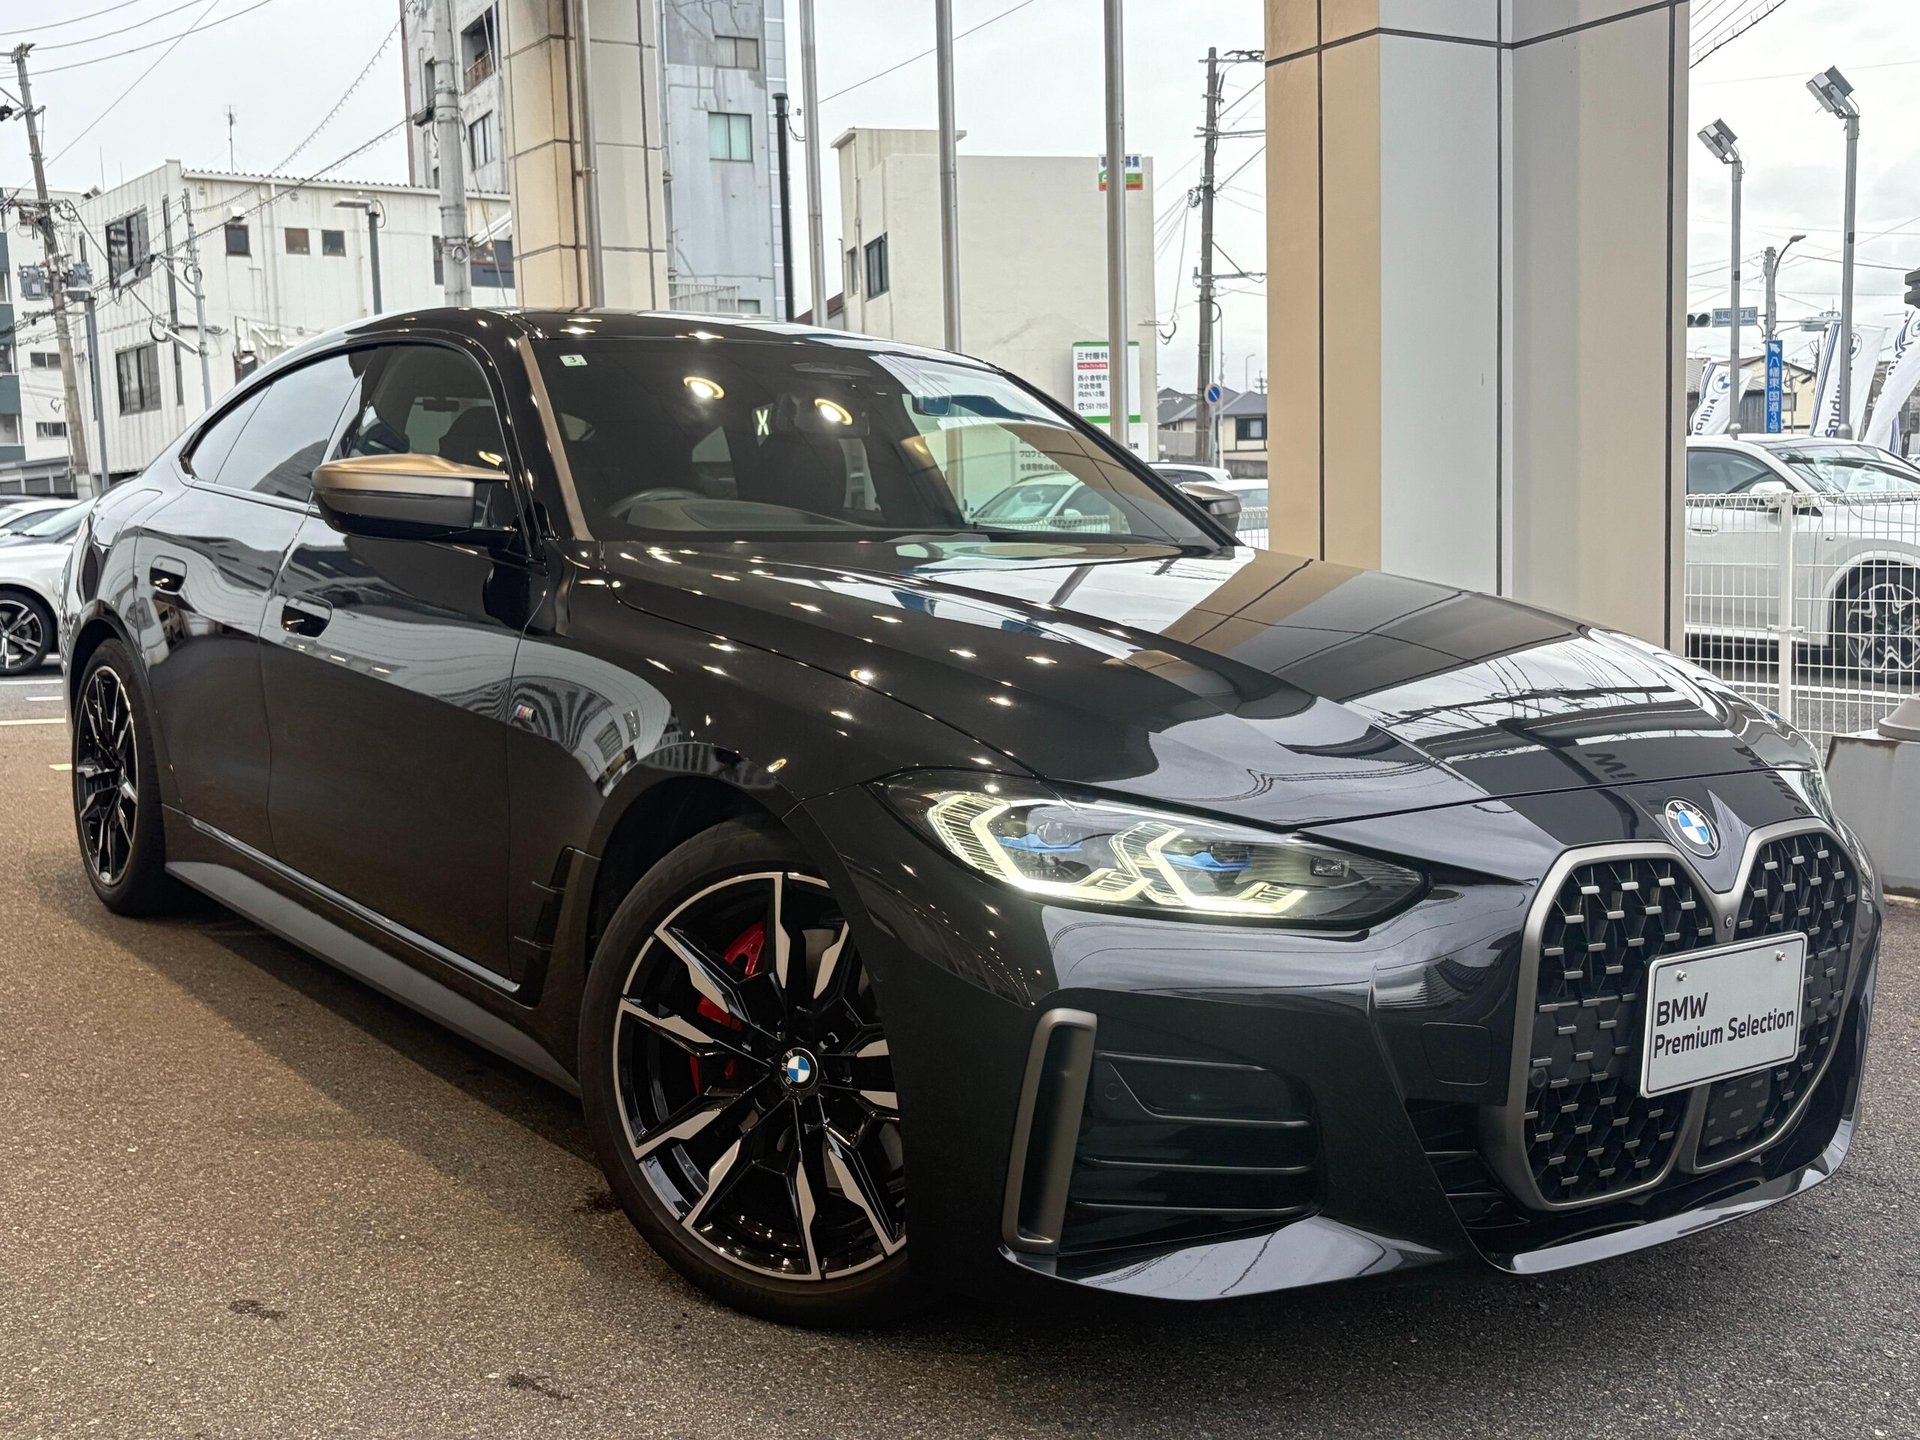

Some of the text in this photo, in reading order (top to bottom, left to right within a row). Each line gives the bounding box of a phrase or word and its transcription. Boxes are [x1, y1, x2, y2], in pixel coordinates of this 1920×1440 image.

[1077, 352, 1108, 361] 三村眼科
[1655, 992, 1709, 1027] BMW
[1653, 1008, 1795, 1059] Premium Selection
